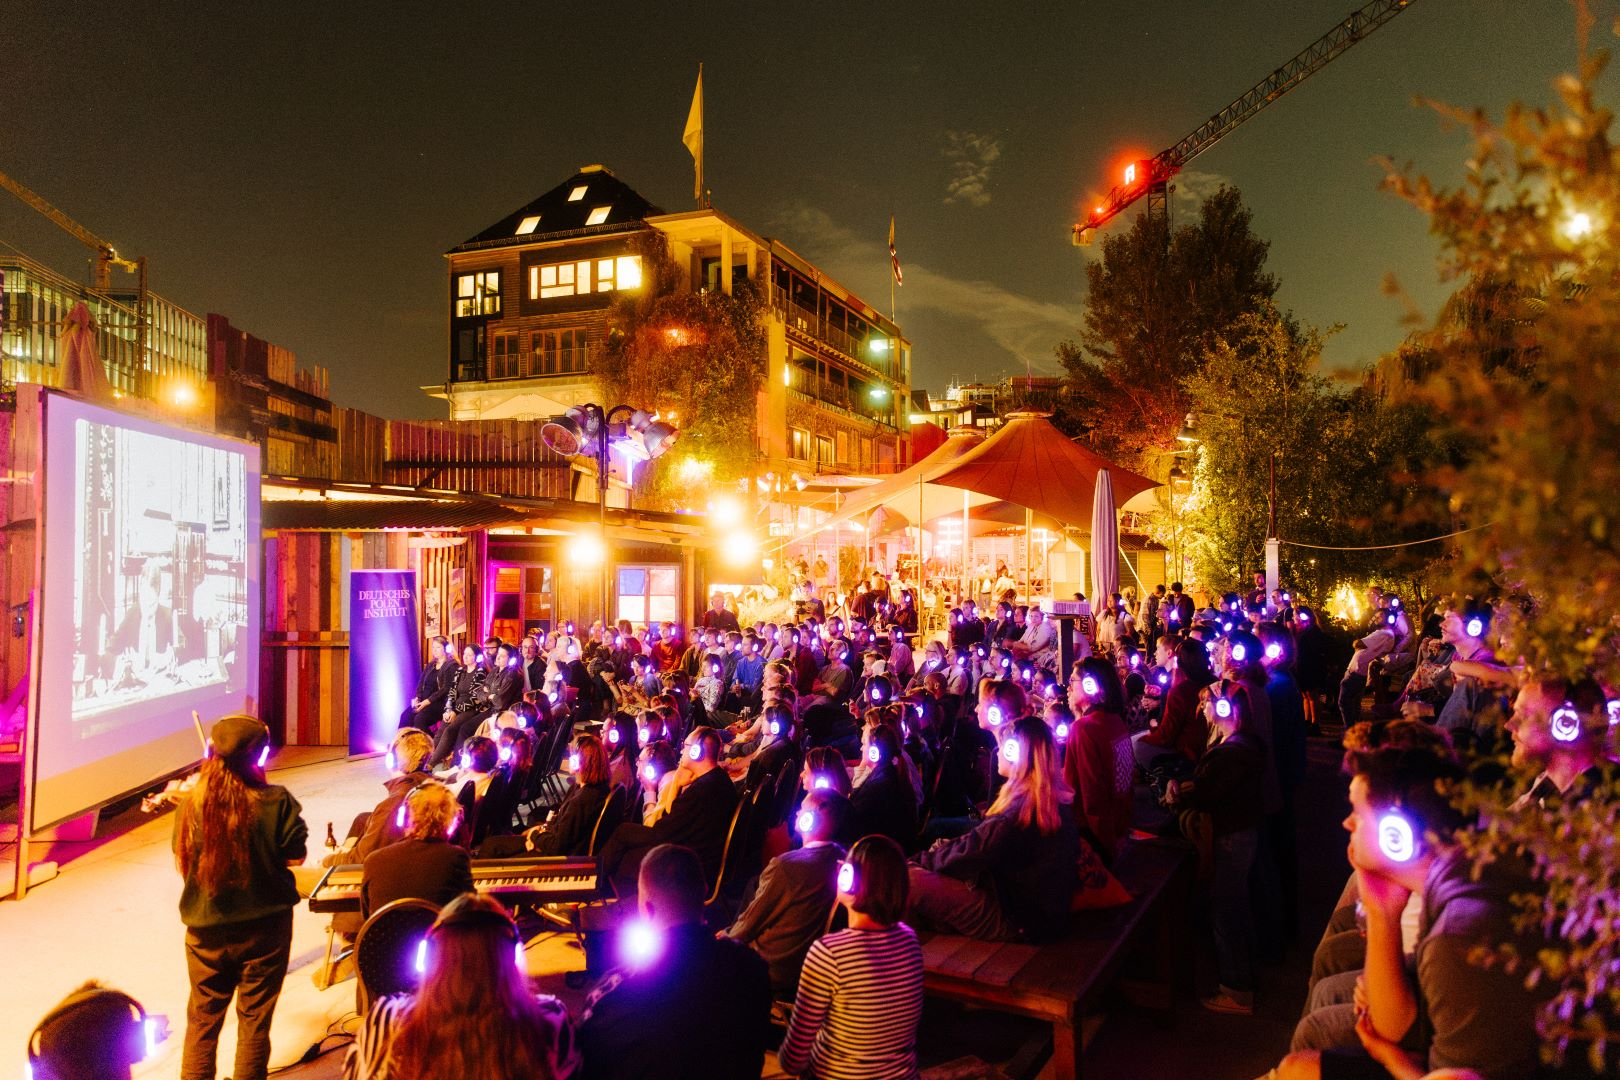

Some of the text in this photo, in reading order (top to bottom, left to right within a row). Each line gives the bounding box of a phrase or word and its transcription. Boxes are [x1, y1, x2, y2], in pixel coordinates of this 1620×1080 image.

[359, 590, 410, 600] DEUTSCHES
[370, 599, 400, 609] POLEN
[364, 607, 407, 618] INSTITUT
